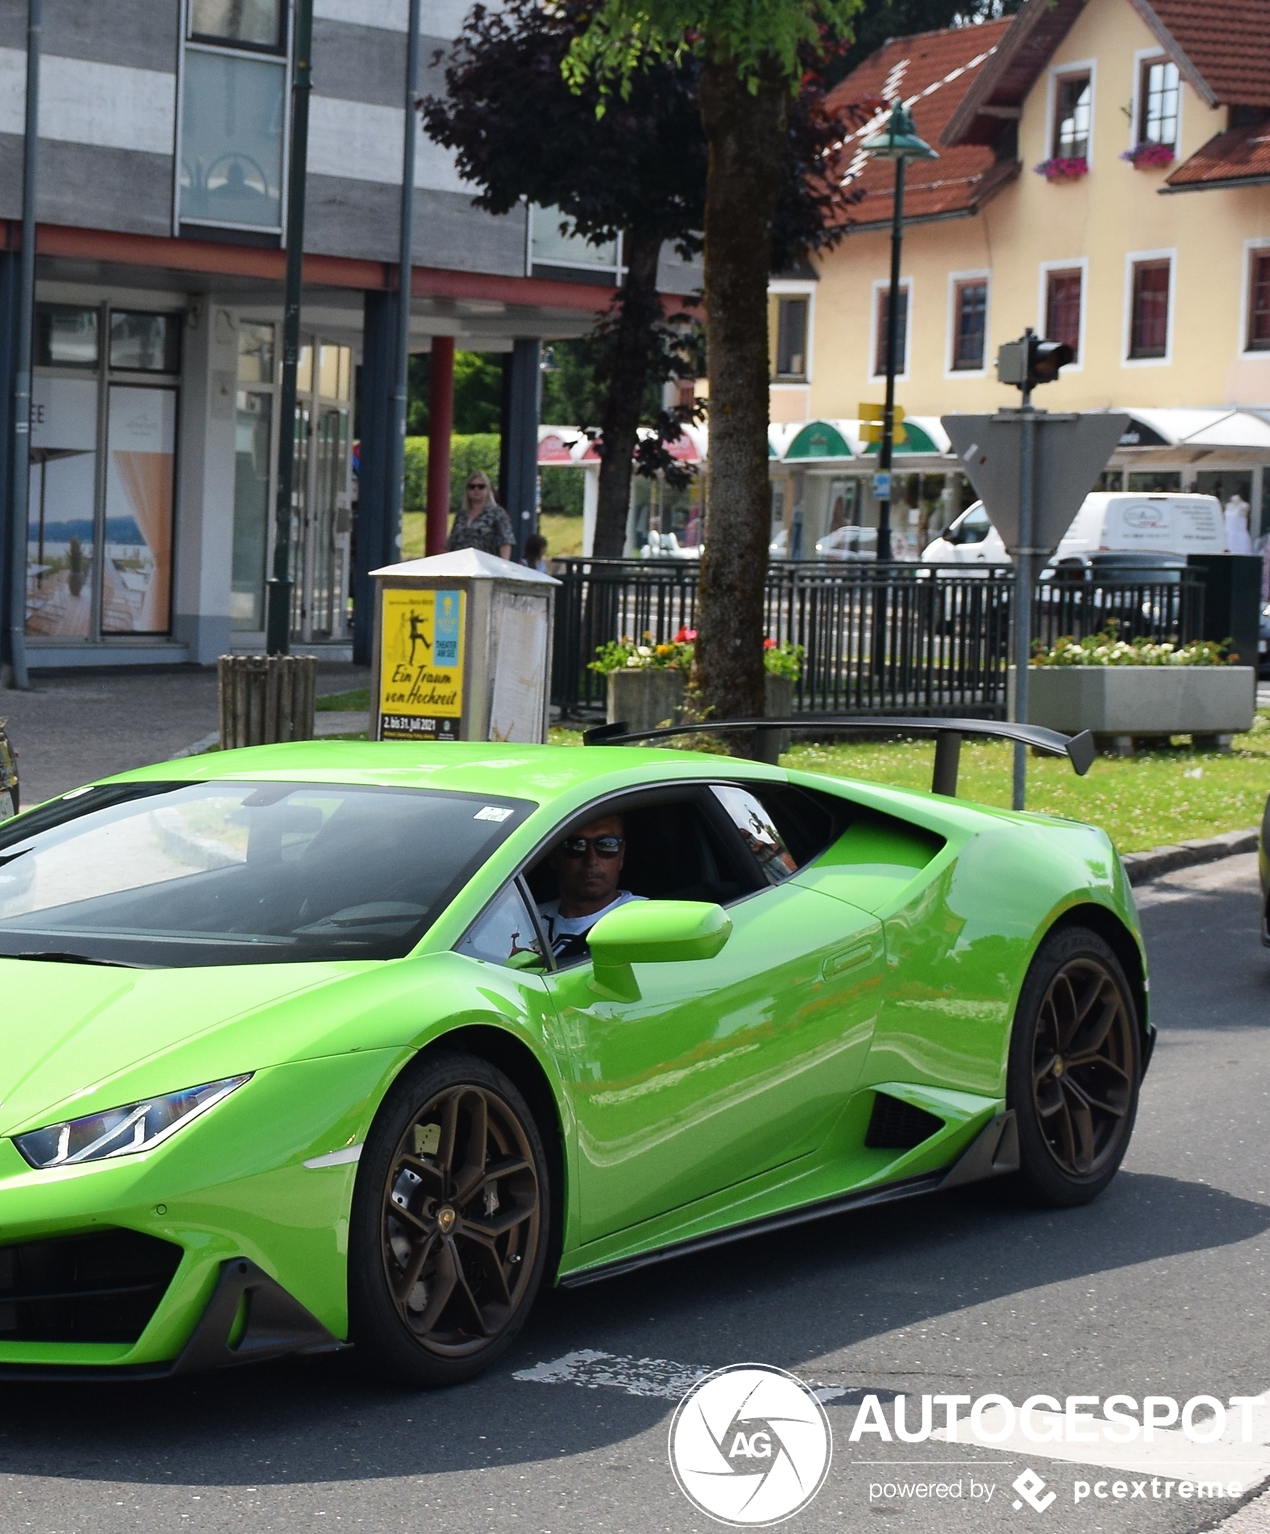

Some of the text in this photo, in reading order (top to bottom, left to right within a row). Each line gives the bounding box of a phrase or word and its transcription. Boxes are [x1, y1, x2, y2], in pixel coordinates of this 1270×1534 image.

[435, 640, 457, 650] THEATER
[437, 649, 455, 658] AM SEE
[392, 664, 451, 684] Ein Traum
[386, 685, 458, 705] von Hochzeit
[383, 717, 436, 732] 2. bis 31. Juli 2021
